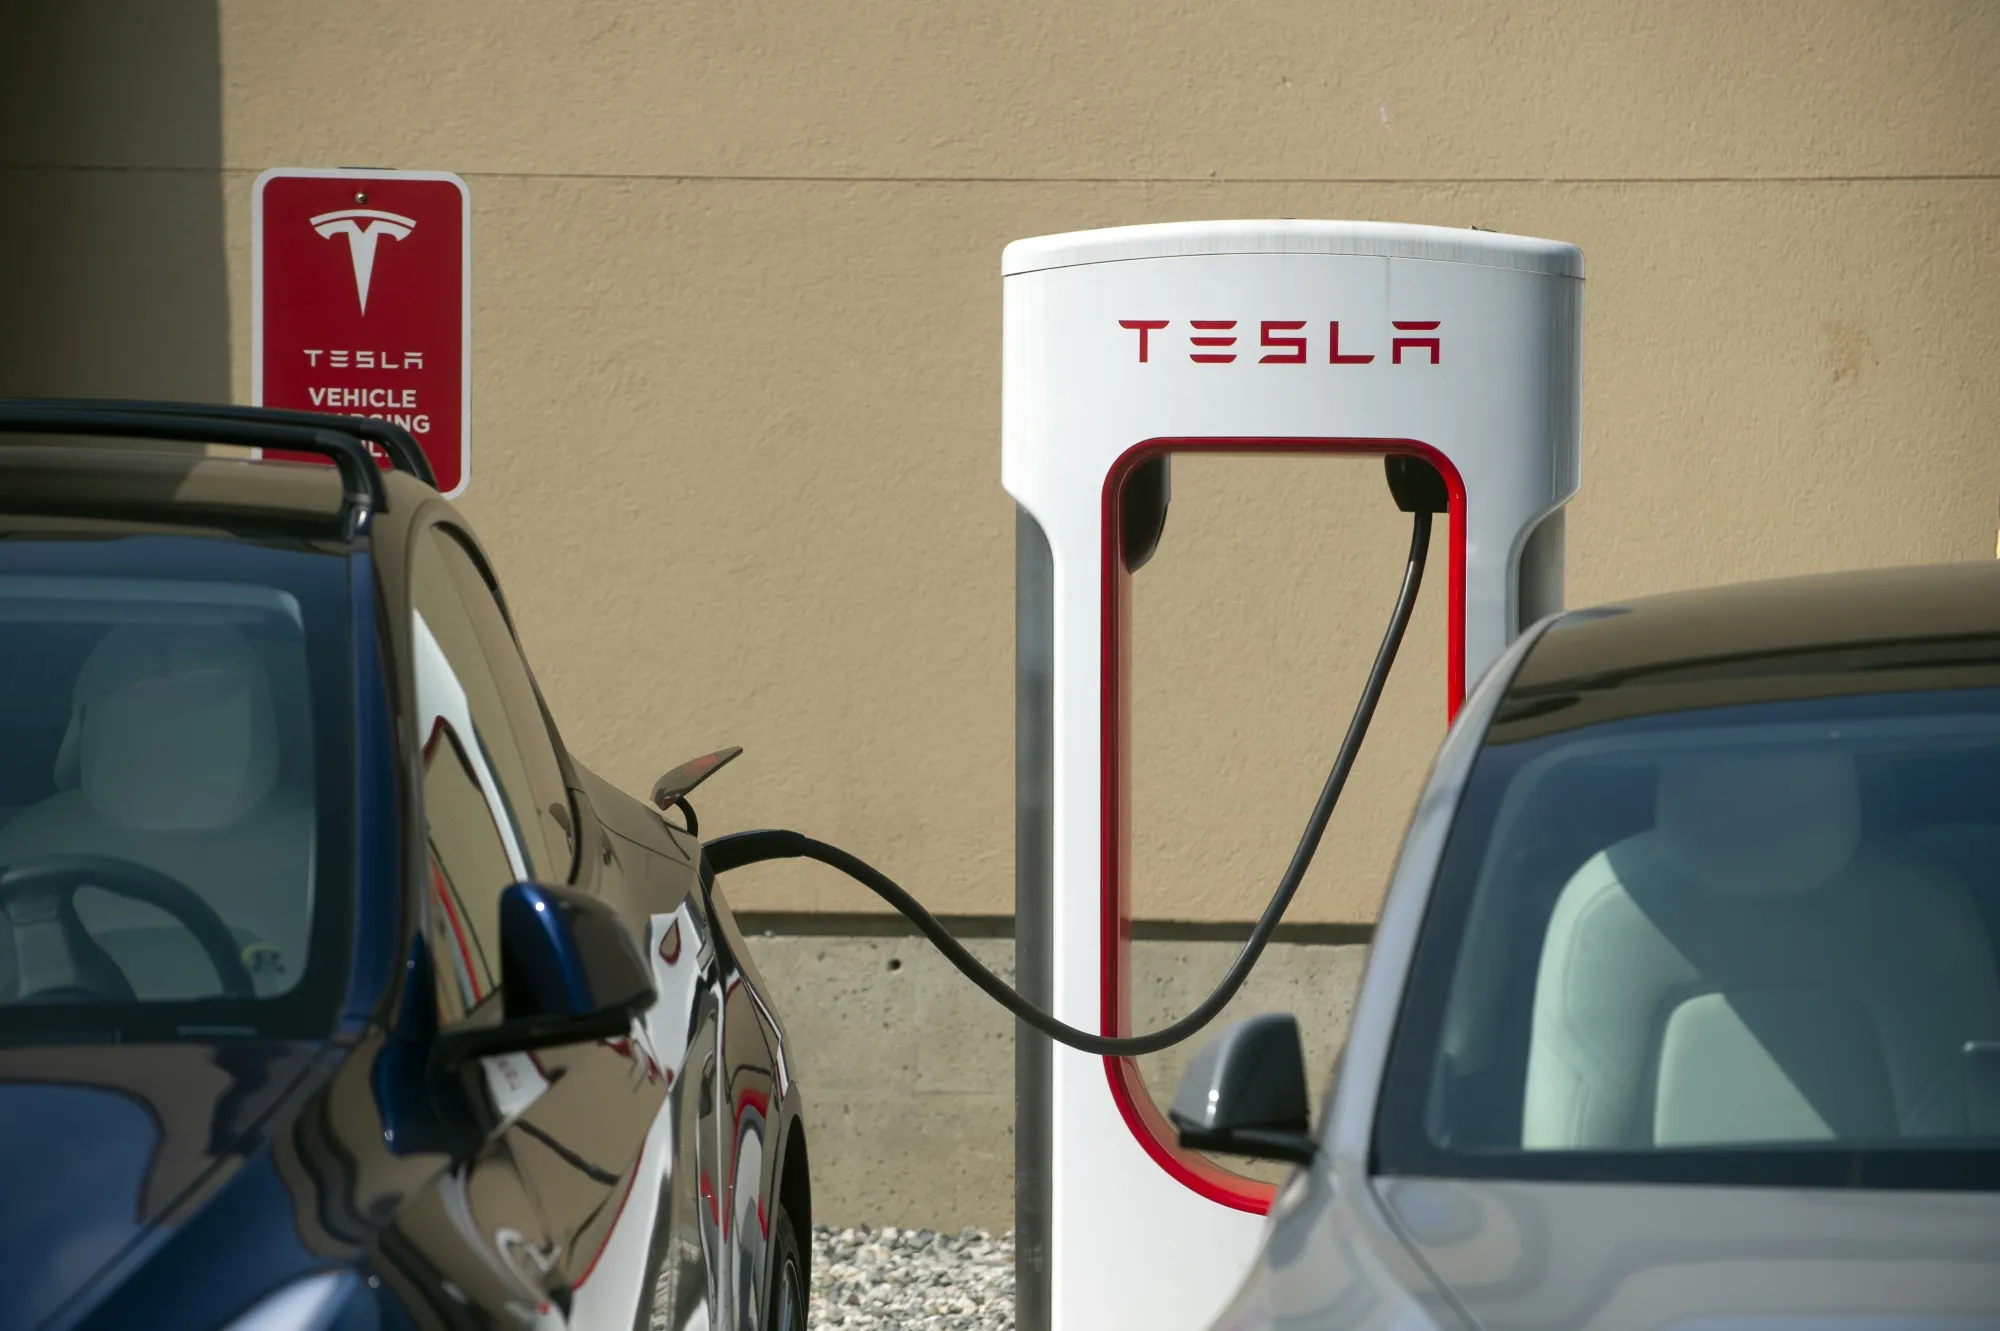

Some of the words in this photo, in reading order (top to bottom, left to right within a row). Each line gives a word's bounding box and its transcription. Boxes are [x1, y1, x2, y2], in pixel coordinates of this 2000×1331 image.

[1118, 320, 1441, 364] TESLA
[303, 350, 423, 369] TESLA
[308, 387, 417, 408] VEHICLE
